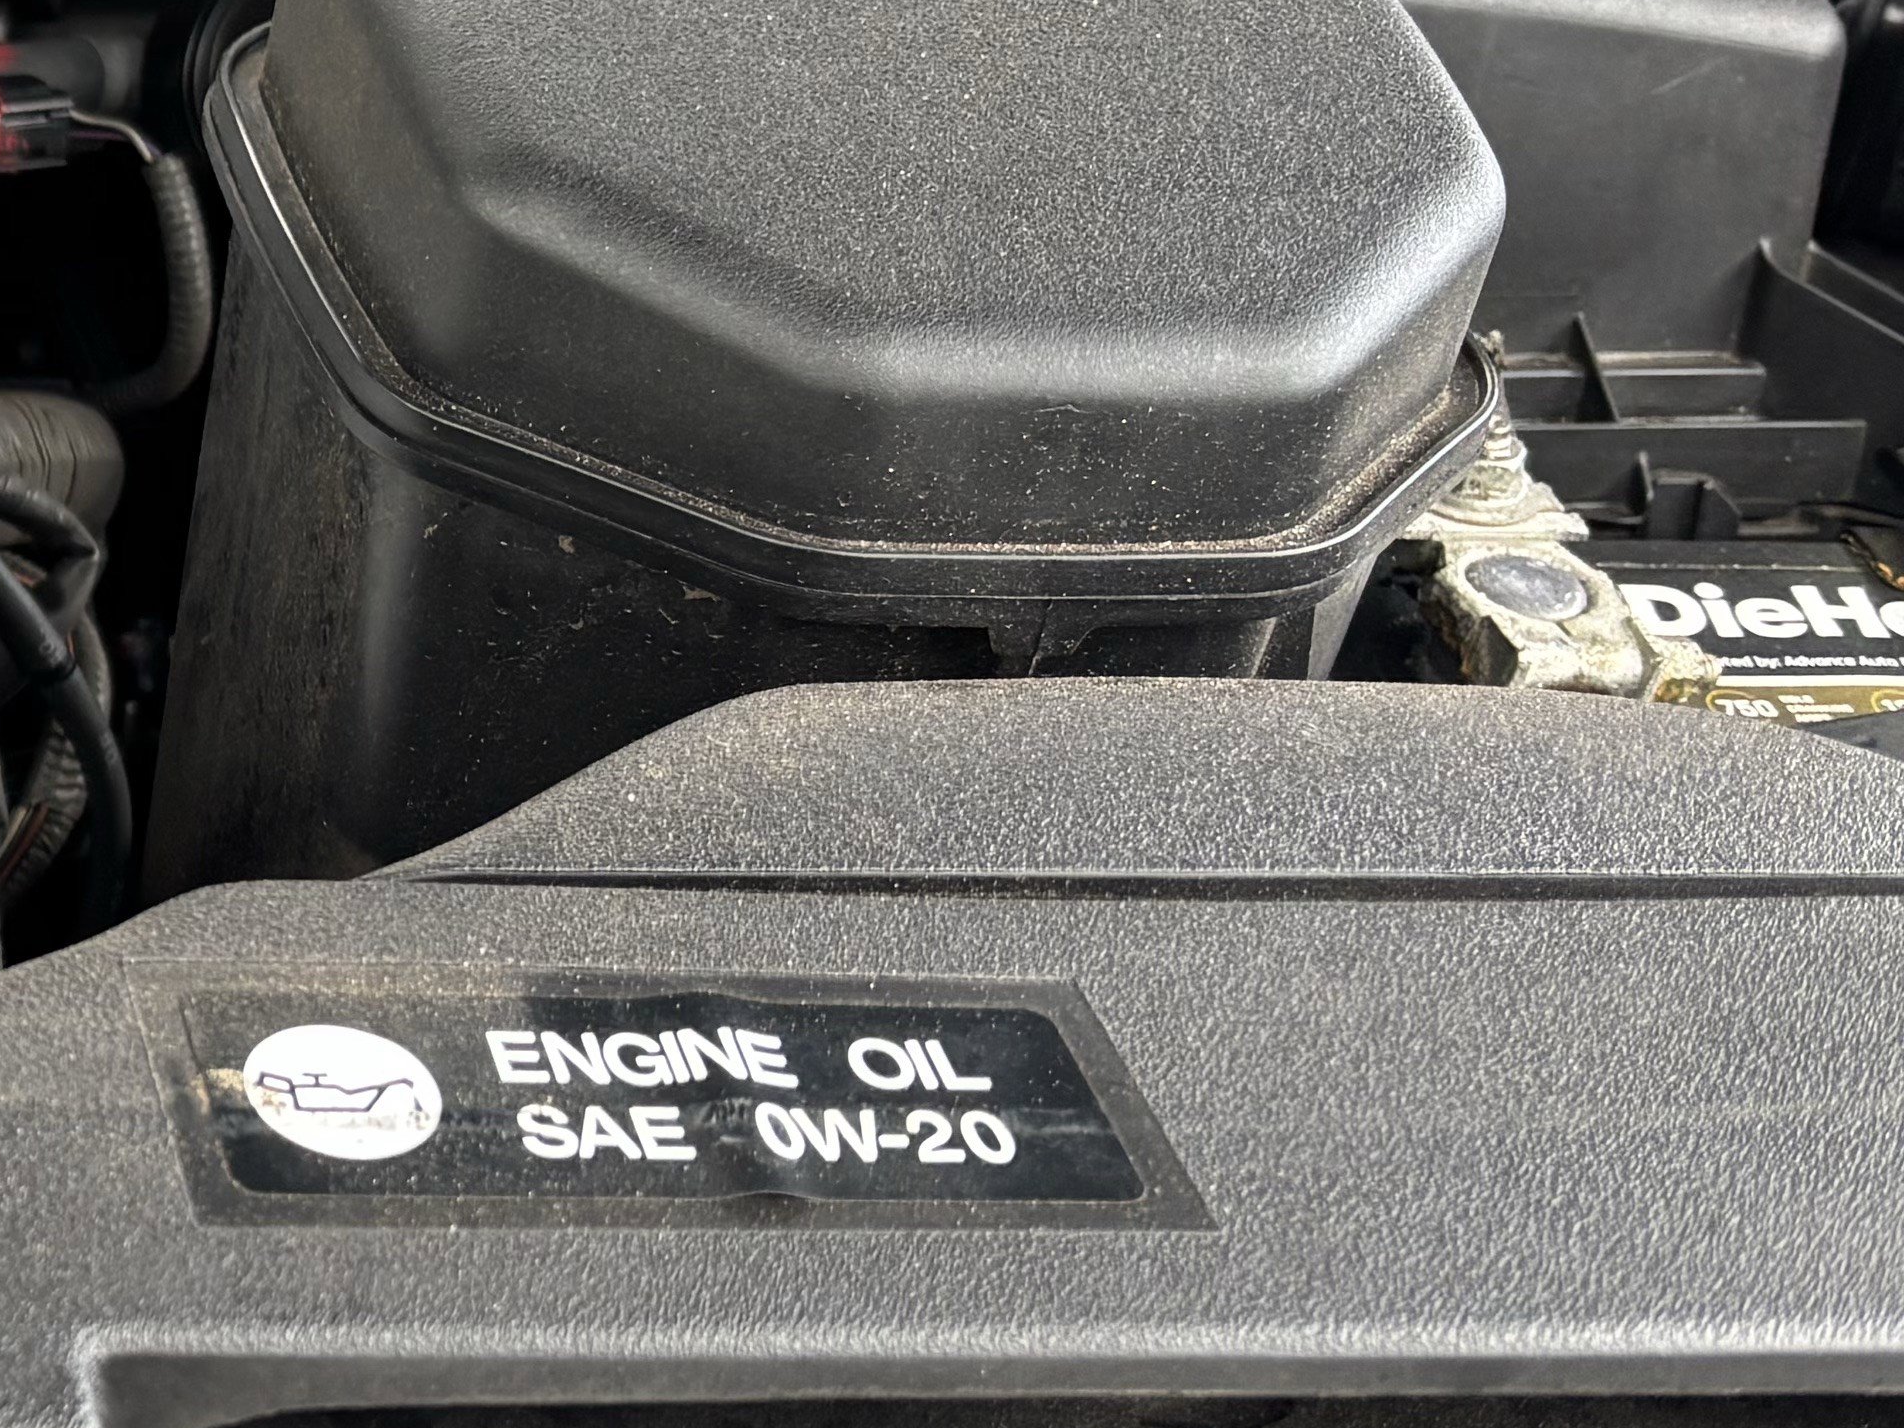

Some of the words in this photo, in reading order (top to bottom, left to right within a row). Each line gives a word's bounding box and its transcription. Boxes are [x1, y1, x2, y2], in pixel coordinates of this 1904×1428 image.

[1714, 698, 1780, 718] 750
[485, 1025, 800, 1090] ENGINE
[846, 1035, 993, 1092] OIL
[515, 1102, 697, 1162] SAE
[753, 1101, 1018, 1165] 0W-20
